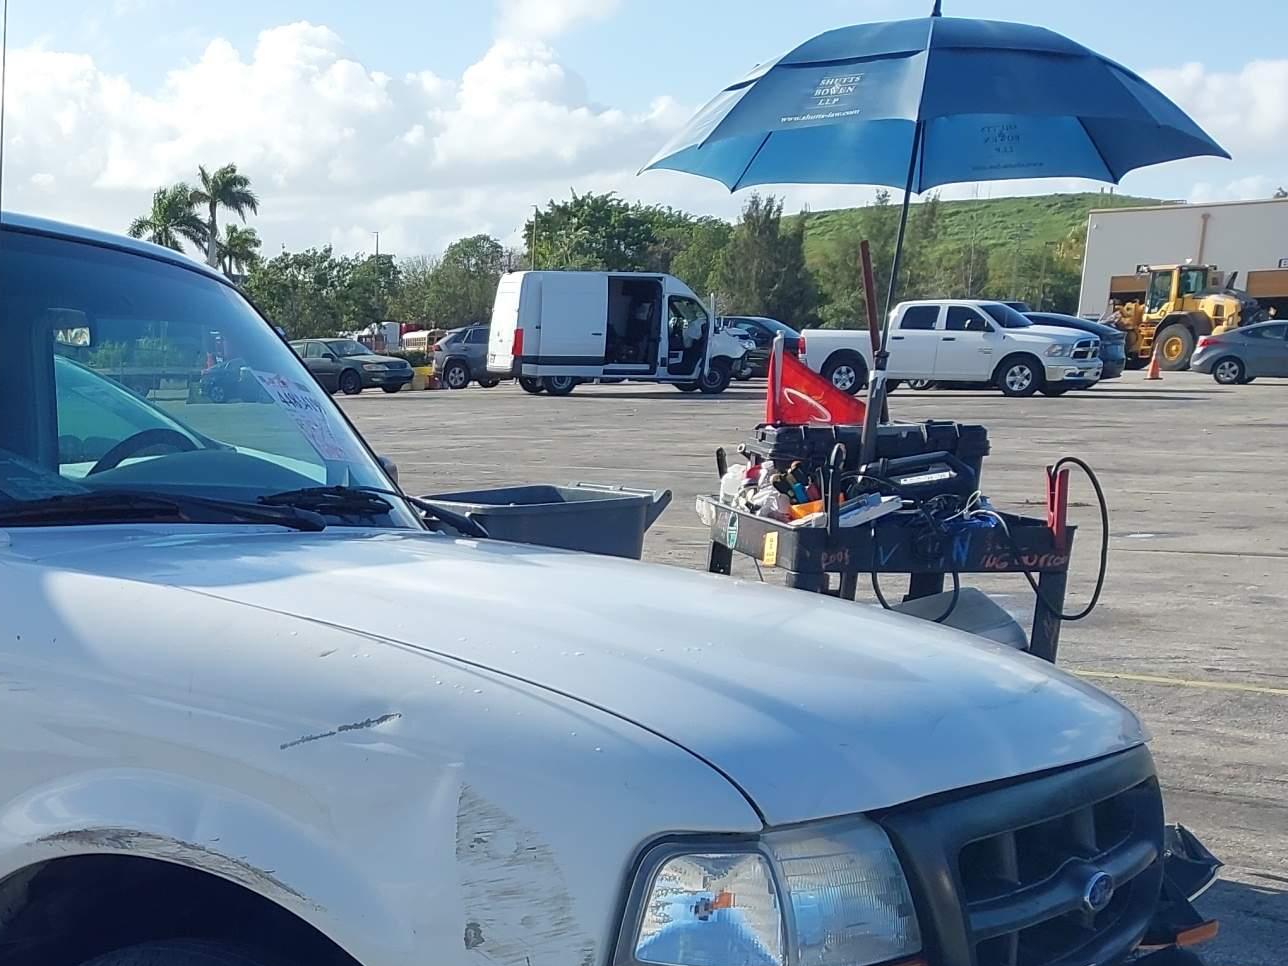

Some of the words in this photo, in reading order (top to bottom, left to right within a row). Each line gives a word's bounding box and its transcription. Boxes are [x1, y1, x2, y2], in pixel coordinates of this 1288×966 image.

[819, 75, 862, 86] SHUTTS
[814, 85, 857, 96] BOWEN
[817, 97, 840, 106] LLP
